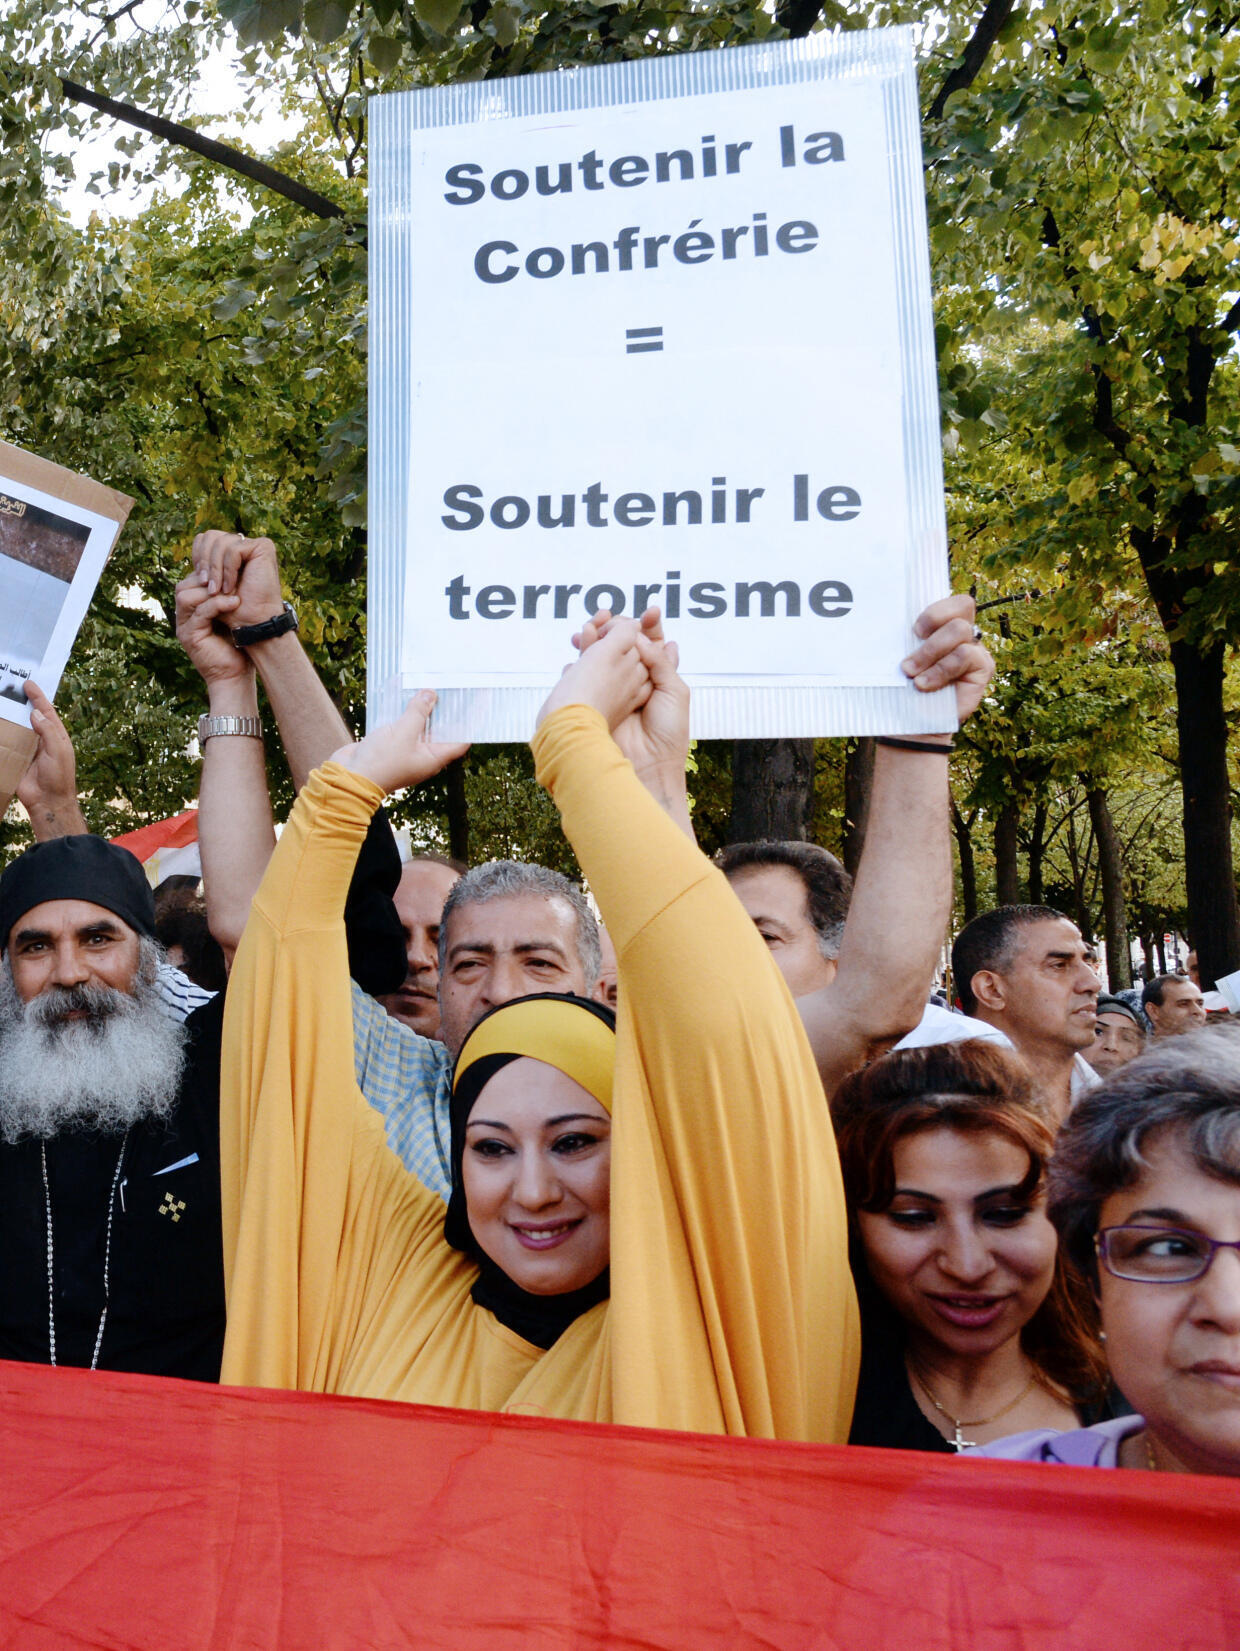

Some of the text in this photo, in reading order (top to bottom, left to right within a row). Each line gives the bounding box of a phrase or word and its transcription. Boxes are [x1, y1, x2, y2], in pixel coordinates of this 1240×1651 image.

[444, 125, 846, 207] Soutenir la
[473, 211, 821, 284] Confrérie
[441, 473, 863, 532] Soutenir le
[445, 570, 855, 621] terrorisme
